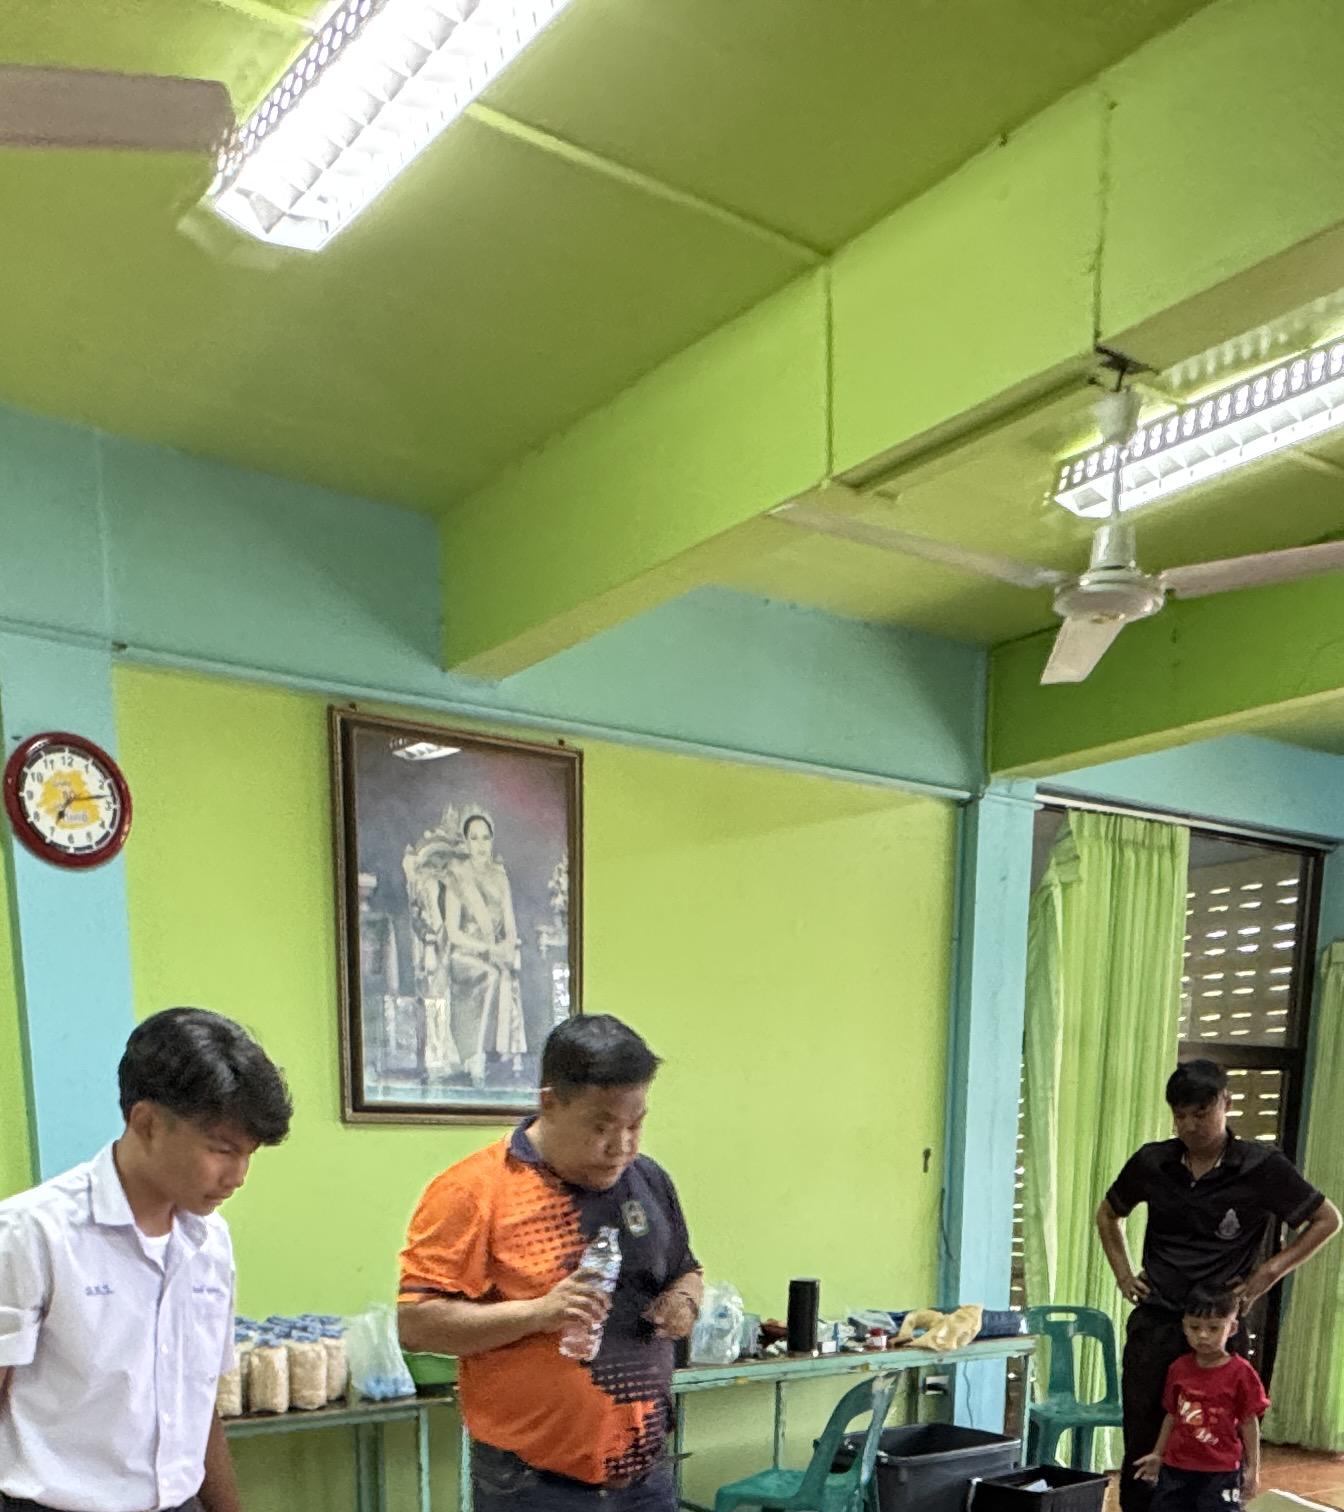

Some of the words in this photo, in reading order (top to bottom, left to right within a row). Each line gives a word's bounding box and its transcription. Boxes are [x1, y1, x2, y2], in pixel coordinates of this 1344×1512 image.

[43, 759, 55, 771] 11
[61, 755, 74, 768] 12
[31, 772, 43, 784] 10
